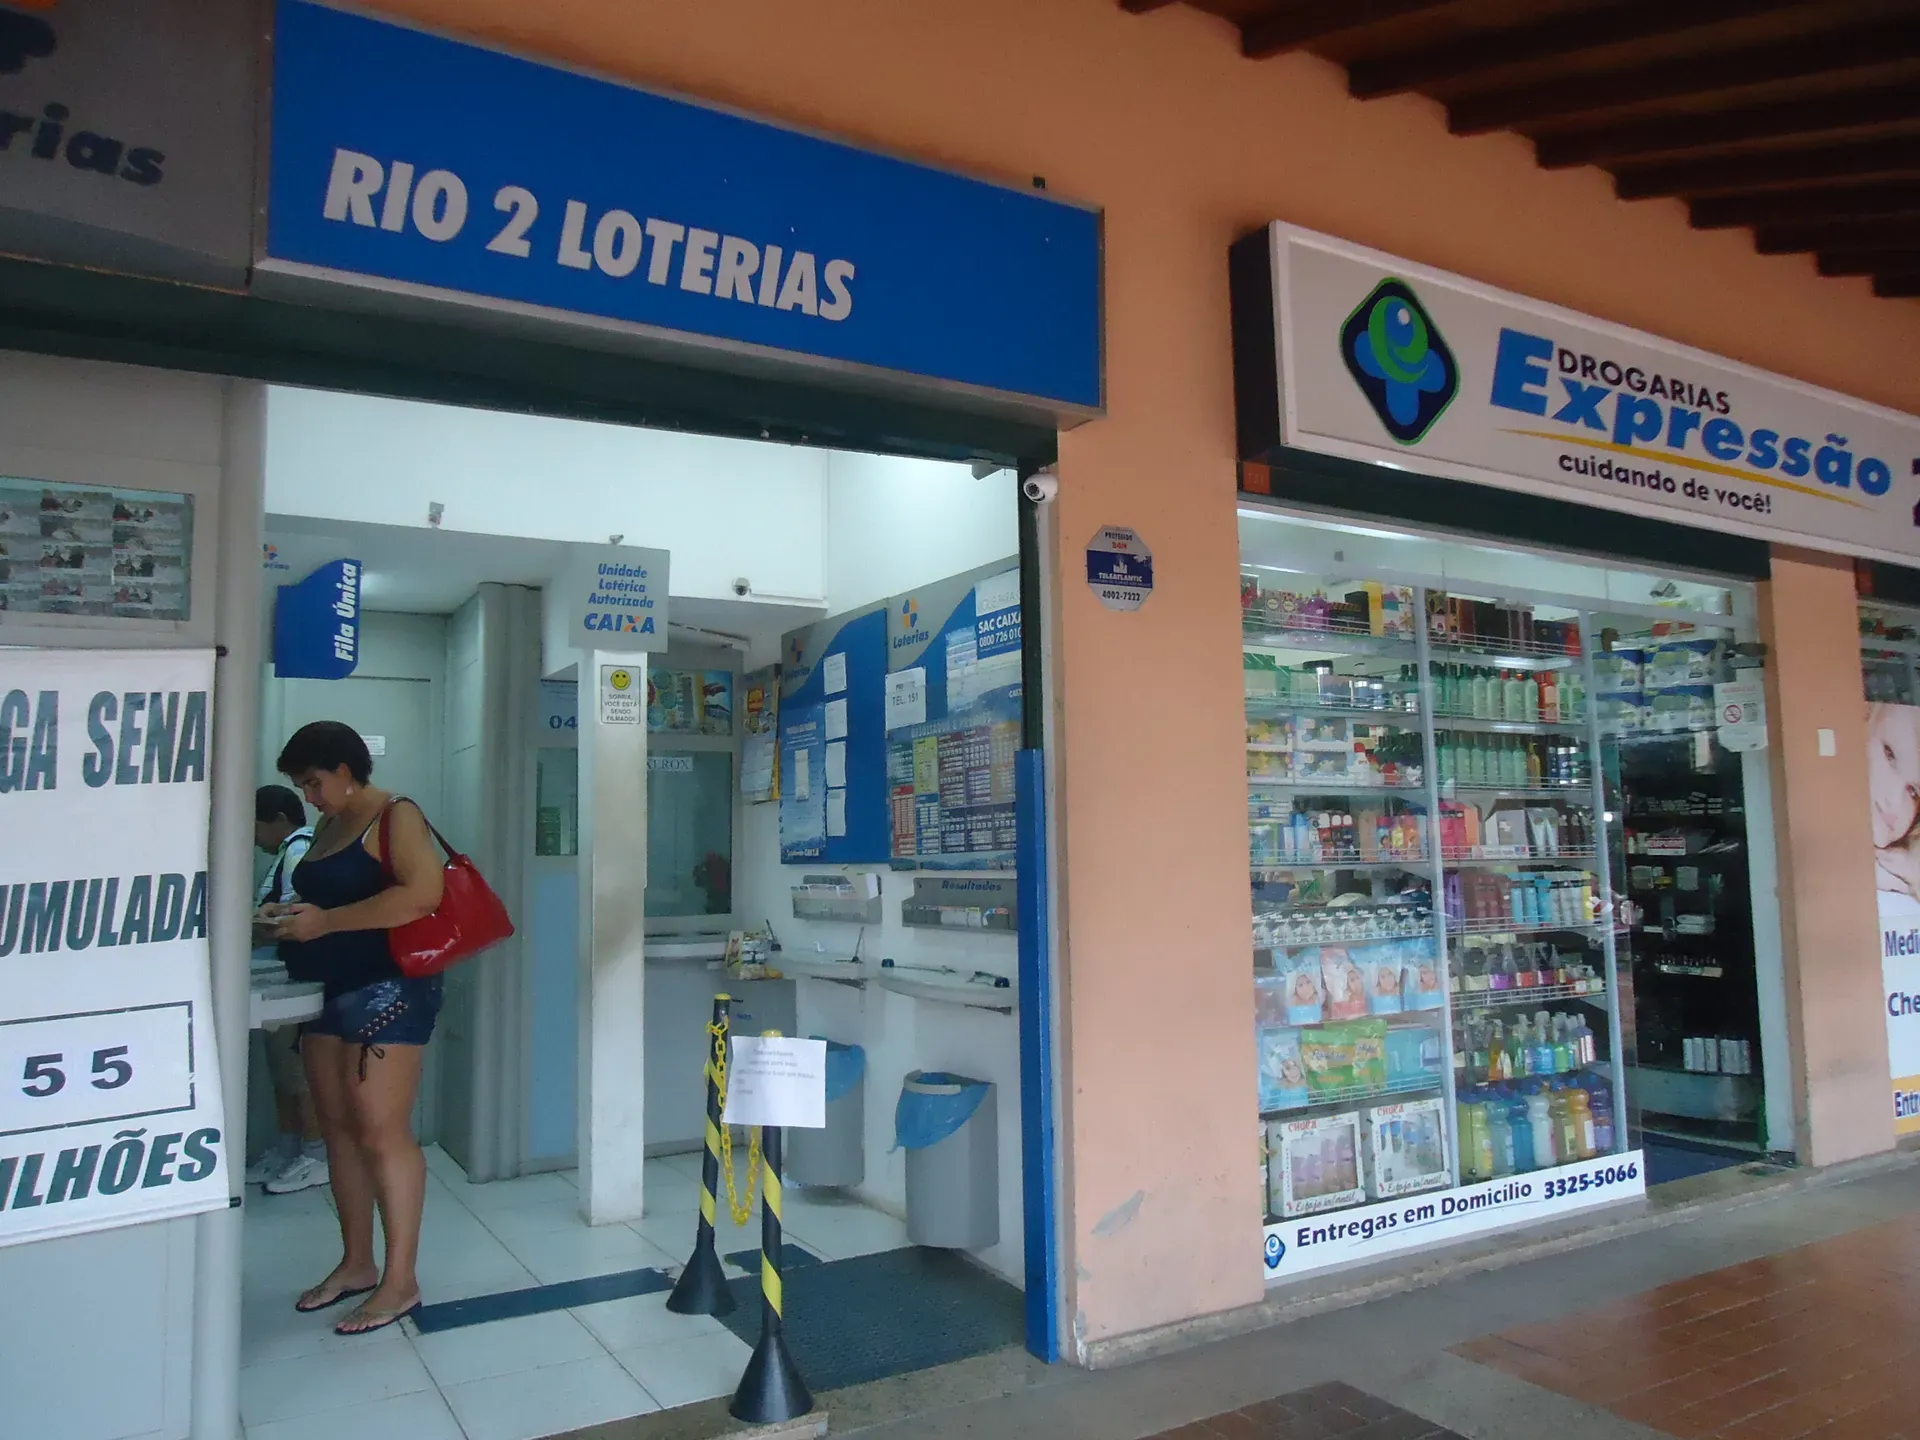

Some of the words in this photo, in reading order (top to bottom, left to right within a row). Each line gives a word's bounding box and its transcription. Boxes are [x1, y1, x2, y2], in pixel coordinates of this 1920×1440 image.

[323, 147, 469, 242] RIO
[485, 185, 539, 258] 2
[556, 199, 856, 322] LOTERIAS
[1557, 347, 1731, 415] DROGARIAS
[1489, 326, 1892, 497] Expressão
[1558, 453, 1676, 494] cuidando
[1682, 475, 1710, 501] de
[1715, 487, 1772, 514] você!
[597, 563, 648, 579] Unidade
[332, 562, 358, 619] Única
[599, 578, 646, 593] Lotérica
[588, 592, 654, 609] Autorizada
[584, 612, 655, 634] CAIXA
[978, 618, 995, 634] SAC
[333, 623, 355, 662] Fila
[893, 629, 930, 649] Loterias
[0, 689, 59, 794] GA
[82, 690, 207, 788] SENA
[941, 879, 1002, 891] Resultados
[1884, 929, 1920, 957] Medi
[1894, 1090, 1920, 1118] Entr
[1296, 1212, 1398, 1248] Entregas
[1403, 1203, 1436, 1224] em
[1441, 1181, 1532, 1215] Domicílio
[1543, 1161, 1639, 1200] 3325-5066
